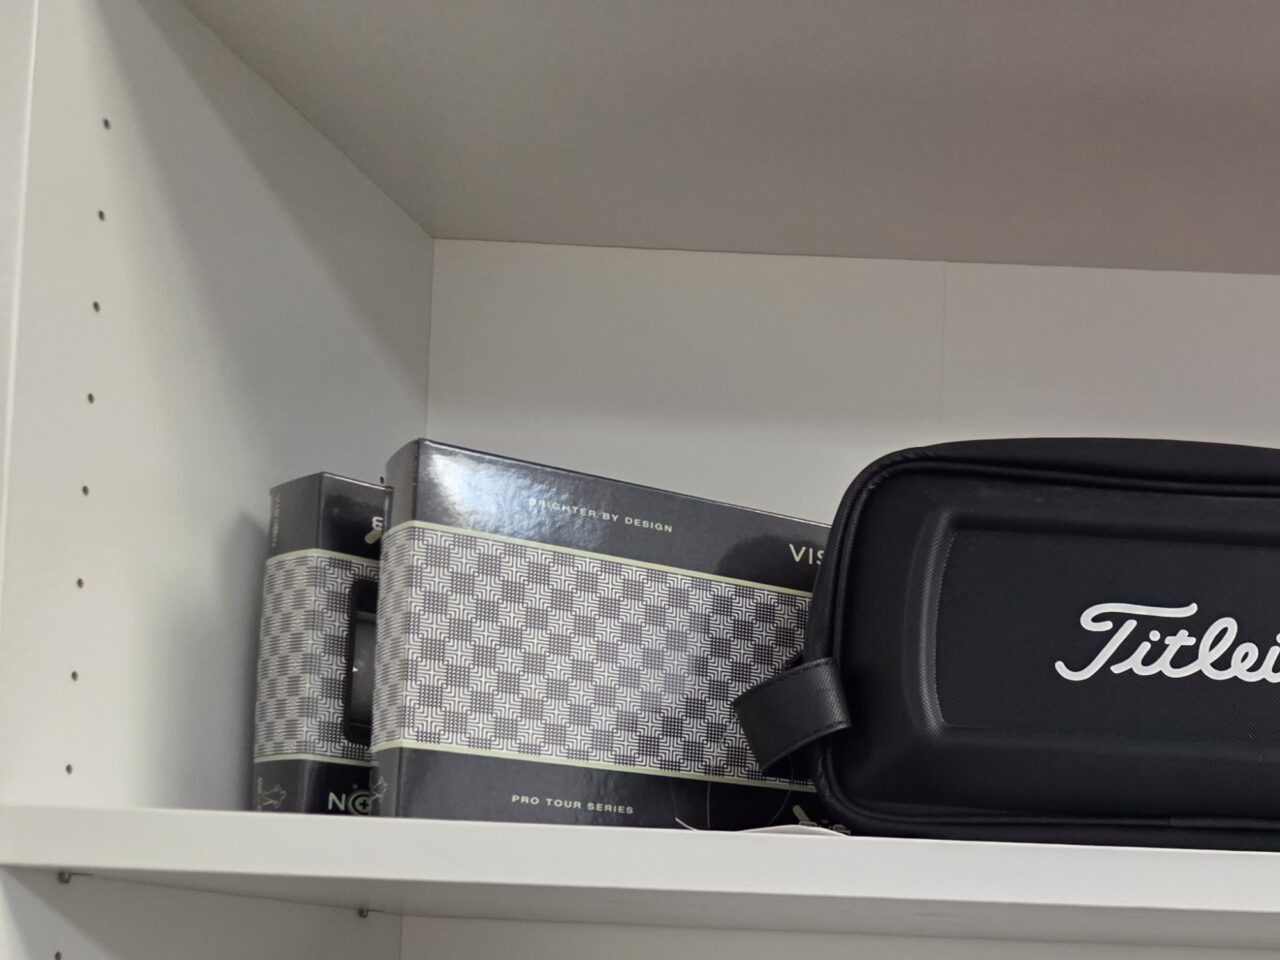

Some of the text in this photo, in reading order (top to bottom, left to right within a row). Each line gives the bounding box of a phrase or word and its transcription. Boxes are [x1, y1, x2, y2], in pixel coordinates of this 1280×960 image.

[528, 498, 673, 533] BRIGHTER BY DESIGN
[511, 794, 634, 815] PRO TOUR SERIES
